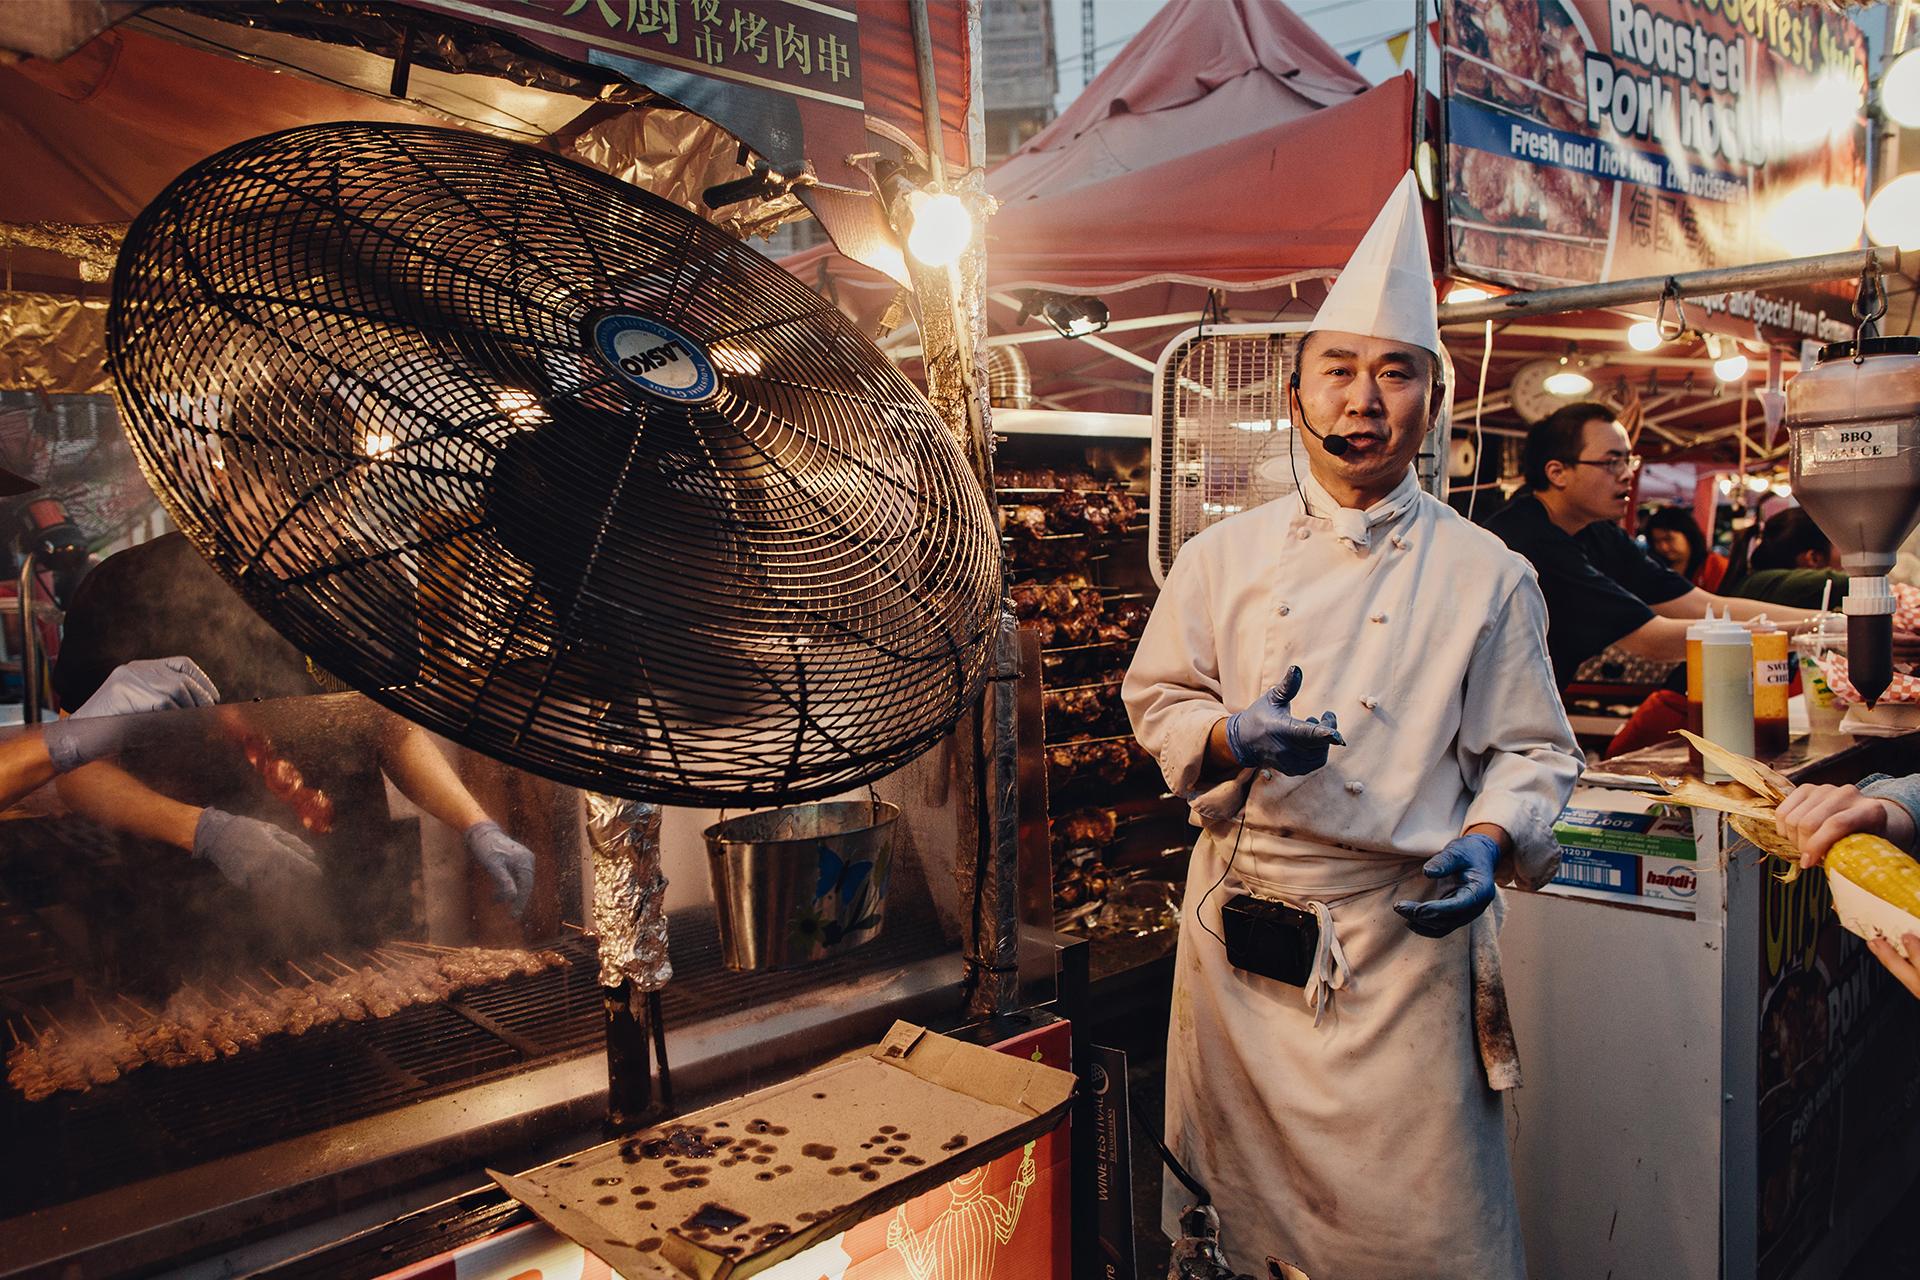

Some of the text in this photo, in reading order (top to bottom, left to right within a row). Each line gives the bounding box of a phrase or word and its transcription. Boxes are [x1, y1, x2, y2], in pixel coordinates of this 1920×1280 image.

[1609, 0, 1746, 95] Roasted
[1586, 57, 1673, 142] Pork
[1510, 124, 1560, 163] Fresh
[1563, 141, 1595, 171] and
[1598, 143, 1627, 178] hot
[1729, 290, 1756, 320] and
[1754, 296, 1793, 329] special
[620, 339, 693, 376] LASKO
[1840, 430, 1873, 444] BBQ
[1094, 1096, 1109, 1201] WINE FESTIVAL
